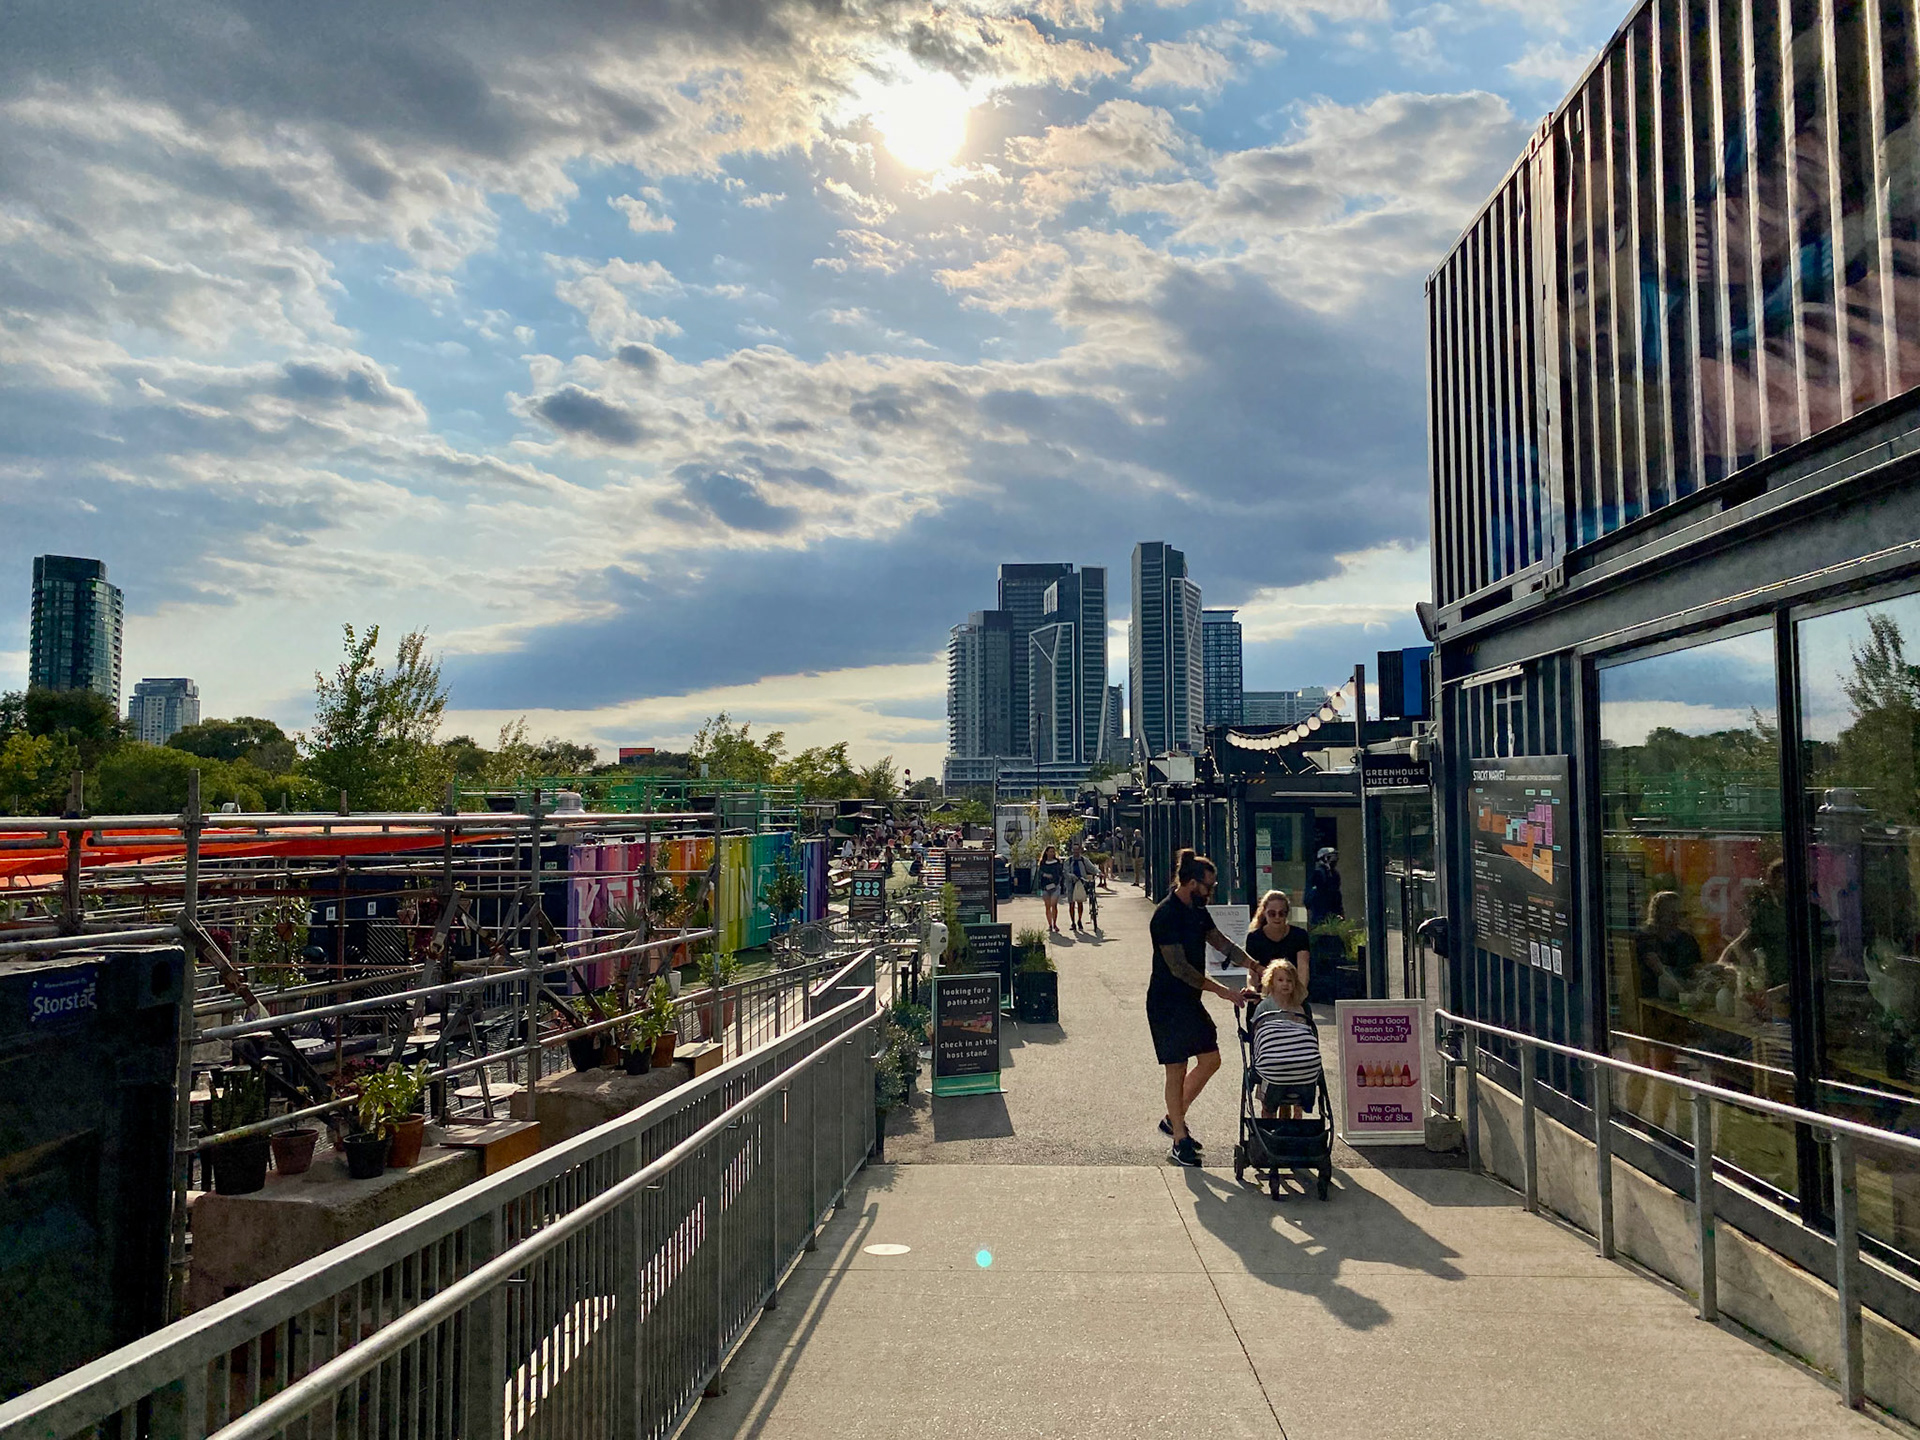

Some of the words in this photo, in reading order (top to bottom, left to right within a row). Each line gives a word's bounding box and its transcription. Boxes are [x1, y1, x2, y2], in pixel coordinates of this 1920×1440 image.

[1365, 768, 1425, 776] GREENHOUSE
[1365, 777, 1394, 785] JUICE
[943, 988, 971, 996] looking
[947, 999, 967, 1007] patio
[1356, 1017, 1377, 1025] Need
[1385, 1016, 1406, 1024] Good
[1396, 1026, 1409, 1035] Try
[1360, 1034, 1405, 1042] Kombucha?
[940, 1041, 962, 1049] check
[974, 1039, 983, 1047] at
[966, 1050, 989, 1058] stand.
